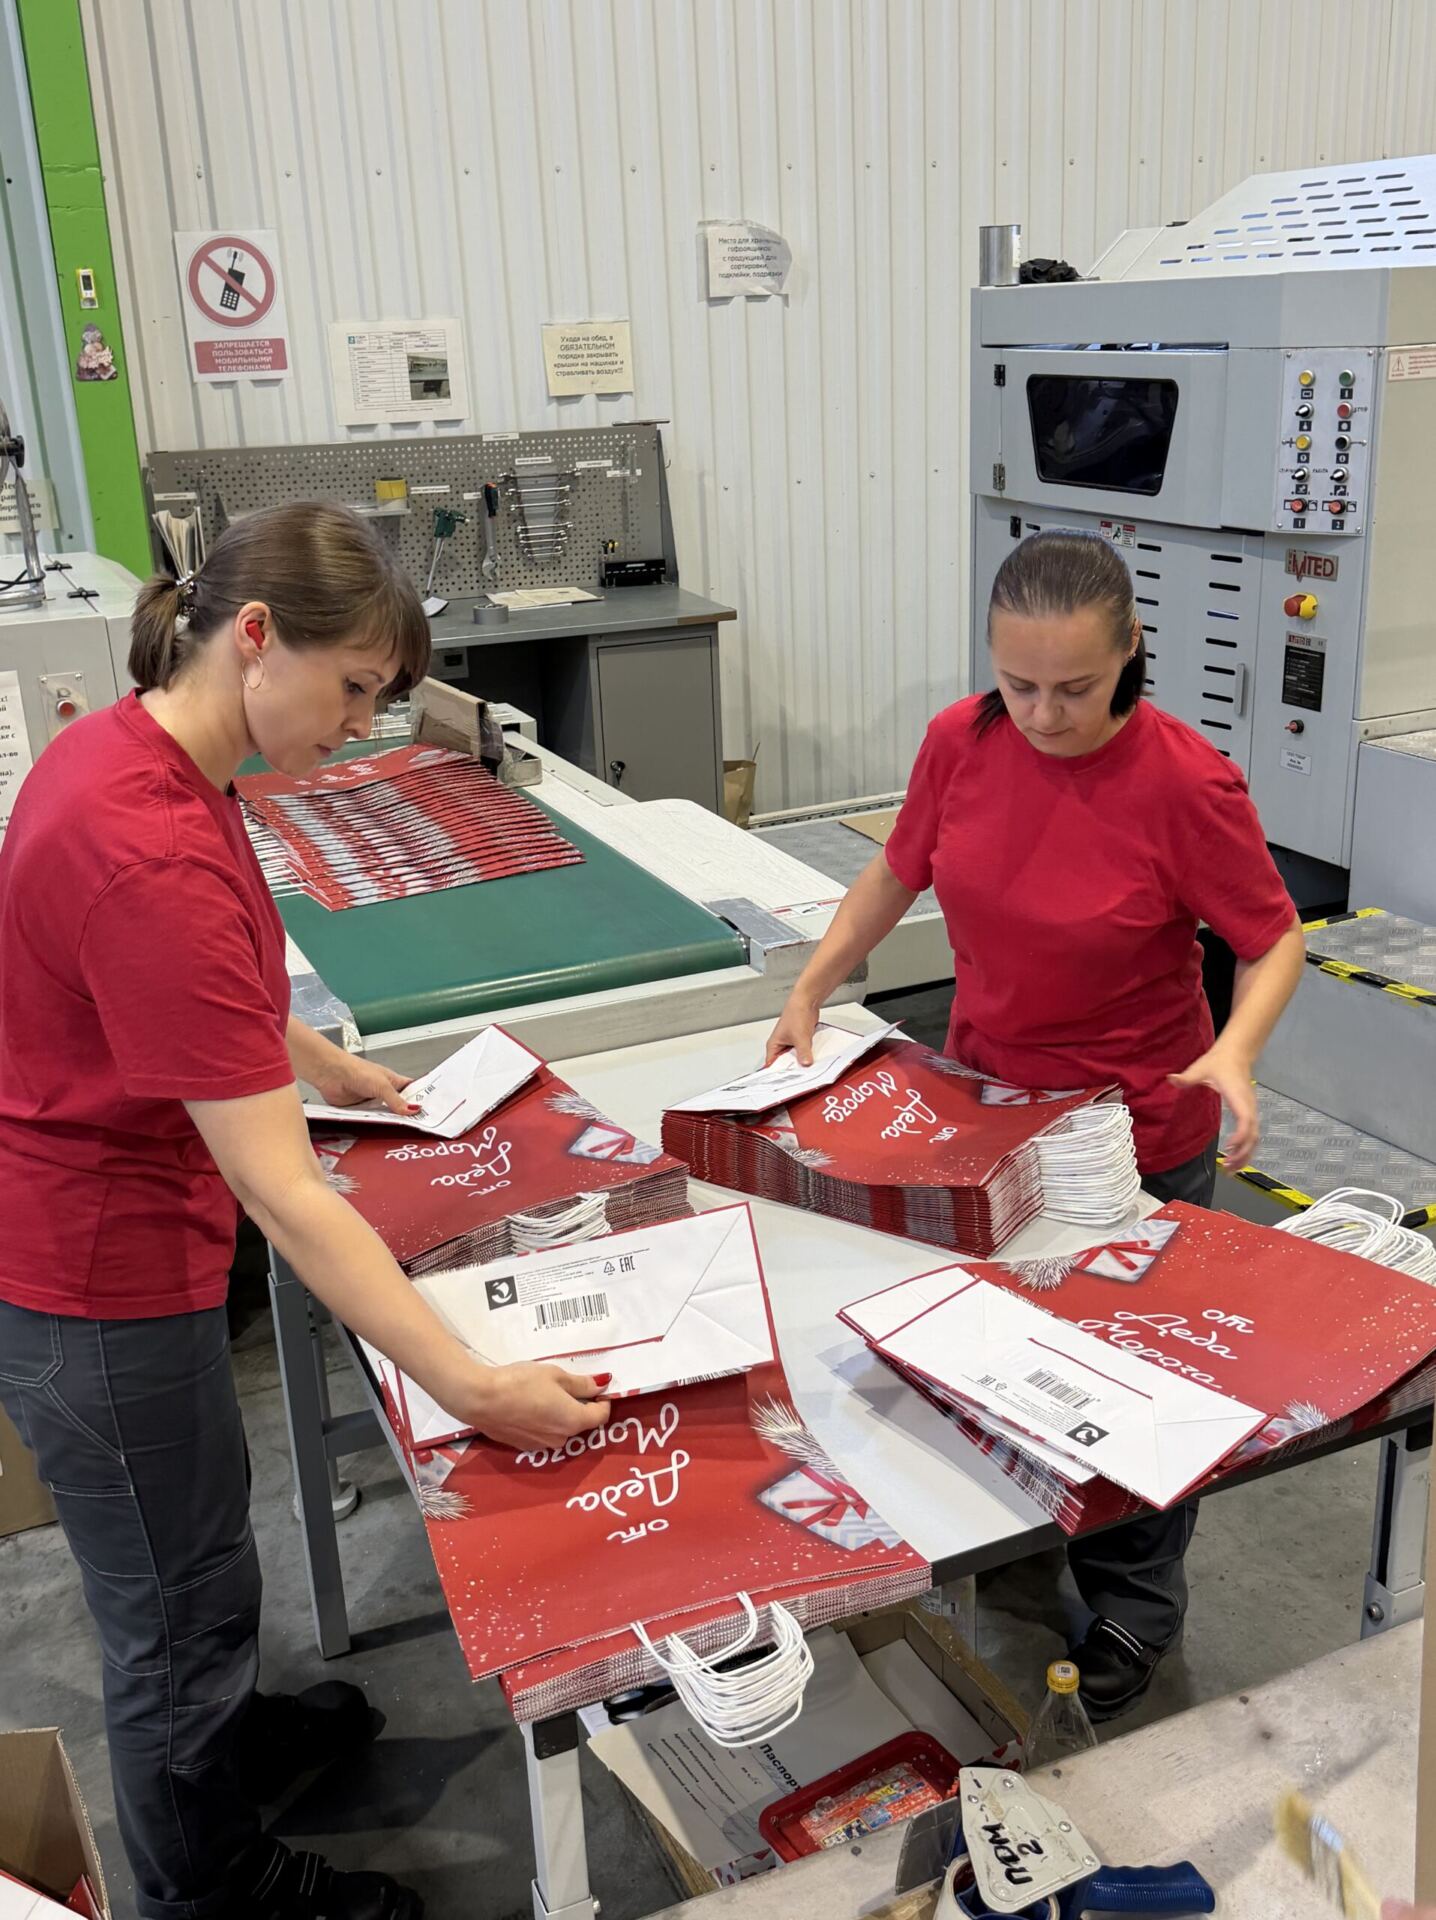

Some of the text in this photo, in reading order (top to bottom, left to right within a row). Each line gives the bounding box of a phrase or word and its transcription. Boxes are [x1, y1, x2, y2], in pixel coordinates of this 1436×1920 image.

[212, 348, 273, 357] ПОЛЬЗОВАТЬСЯ
[213, 340, 270, 349] ЗАПРЕЩАЕТСЯ
[215, 356, 272, 365] МОБИЛЬНЫМИ
[557, 351, 618, 361] порядке закрывать
[218, 364, 271, 372] ТЕЛЕФОНАМИ
[822, 1070, 898, 1123] Мороза
[880, 1088, 938, 1139] Деда
[384, 1126, 497, 1161] Мороза
[928, 1126, 958, 1143] от
[430, 1141, 512, 1186] Деда
[467, 1179, 512, 1197] от
[619, 1255, 636, 1273] EAC
[1201, 1308, 1255, 1334] от
[1113, 1310, 1239, 1360] Деда
[565, 1449, 691, 1517] Деда
[606, 1518, 670, 1544] от
